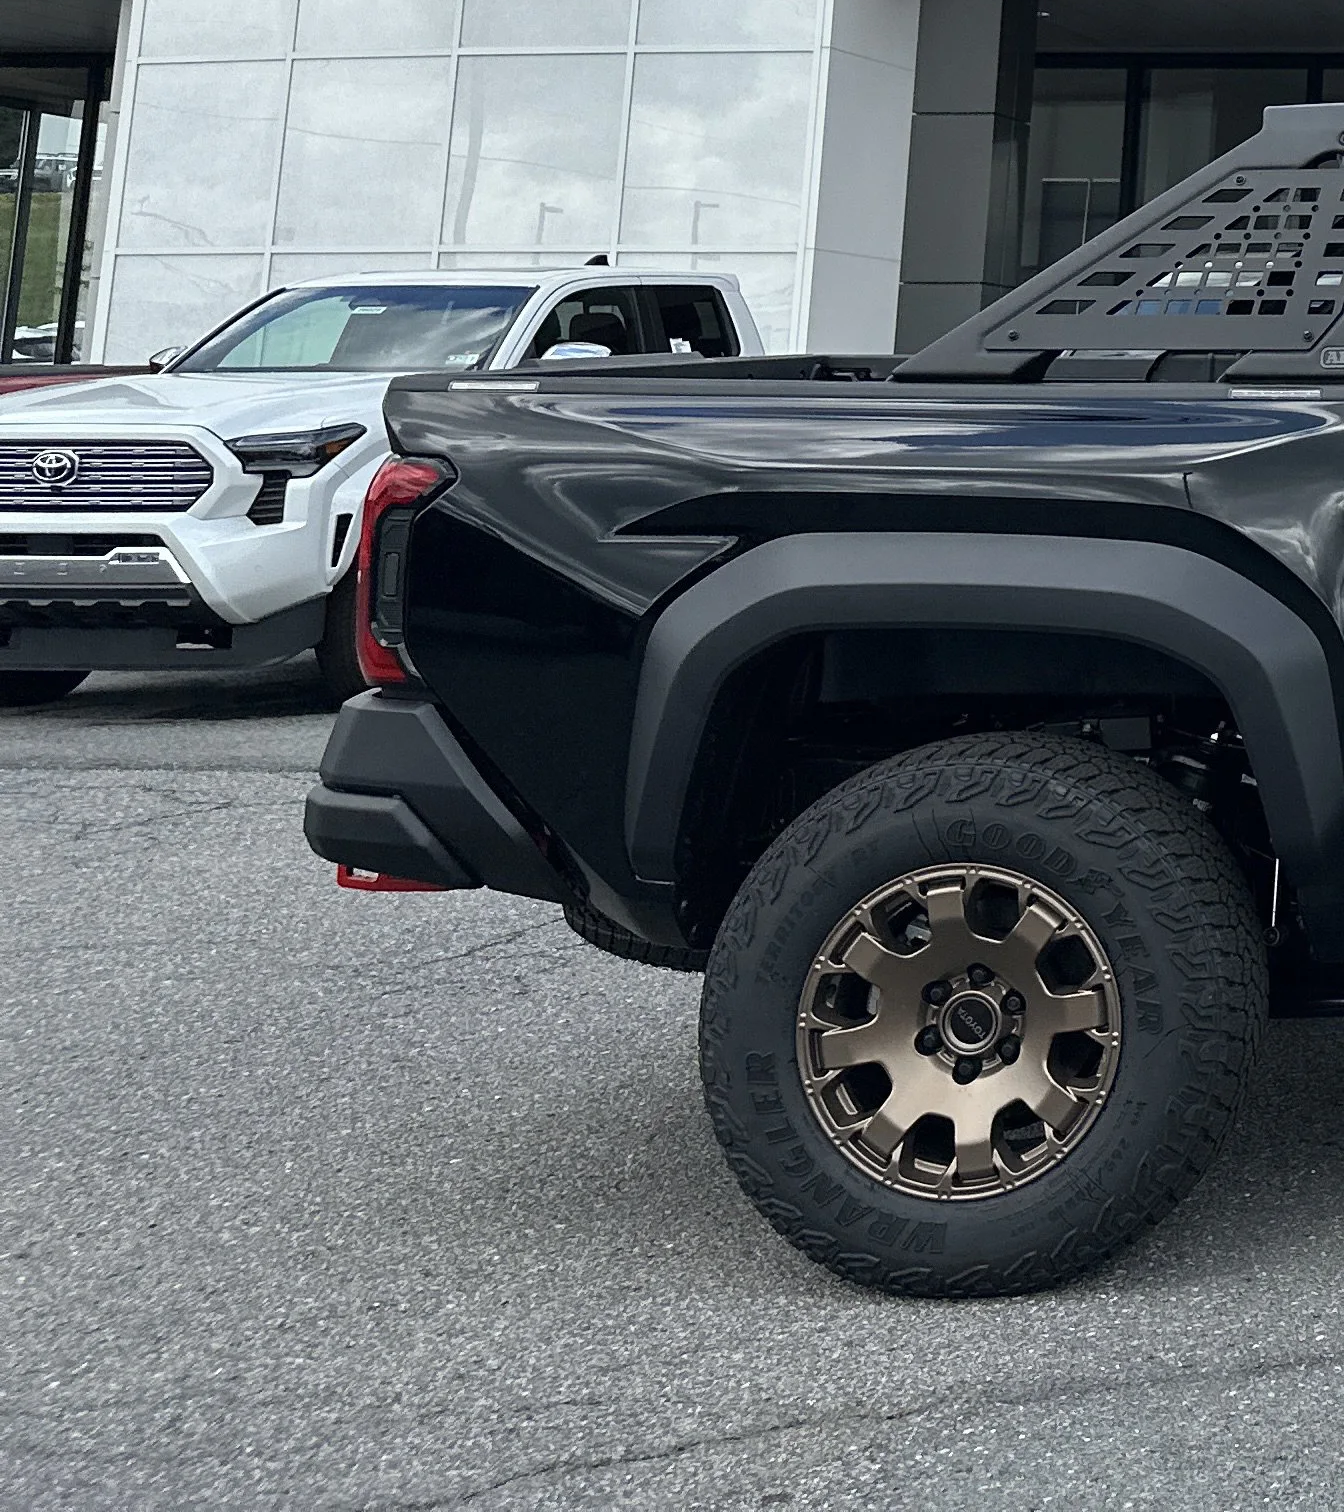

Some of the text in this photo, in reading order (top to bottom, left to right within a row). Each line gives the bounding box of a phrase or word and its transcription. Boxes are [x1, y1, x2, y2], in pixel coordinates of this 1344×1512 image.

[945, 819, 1164, 1034] GOODYEAR
[957, 1006, 986, 1039] TOYOTA
[745, 1050, 948, 1254] WRANGLER
